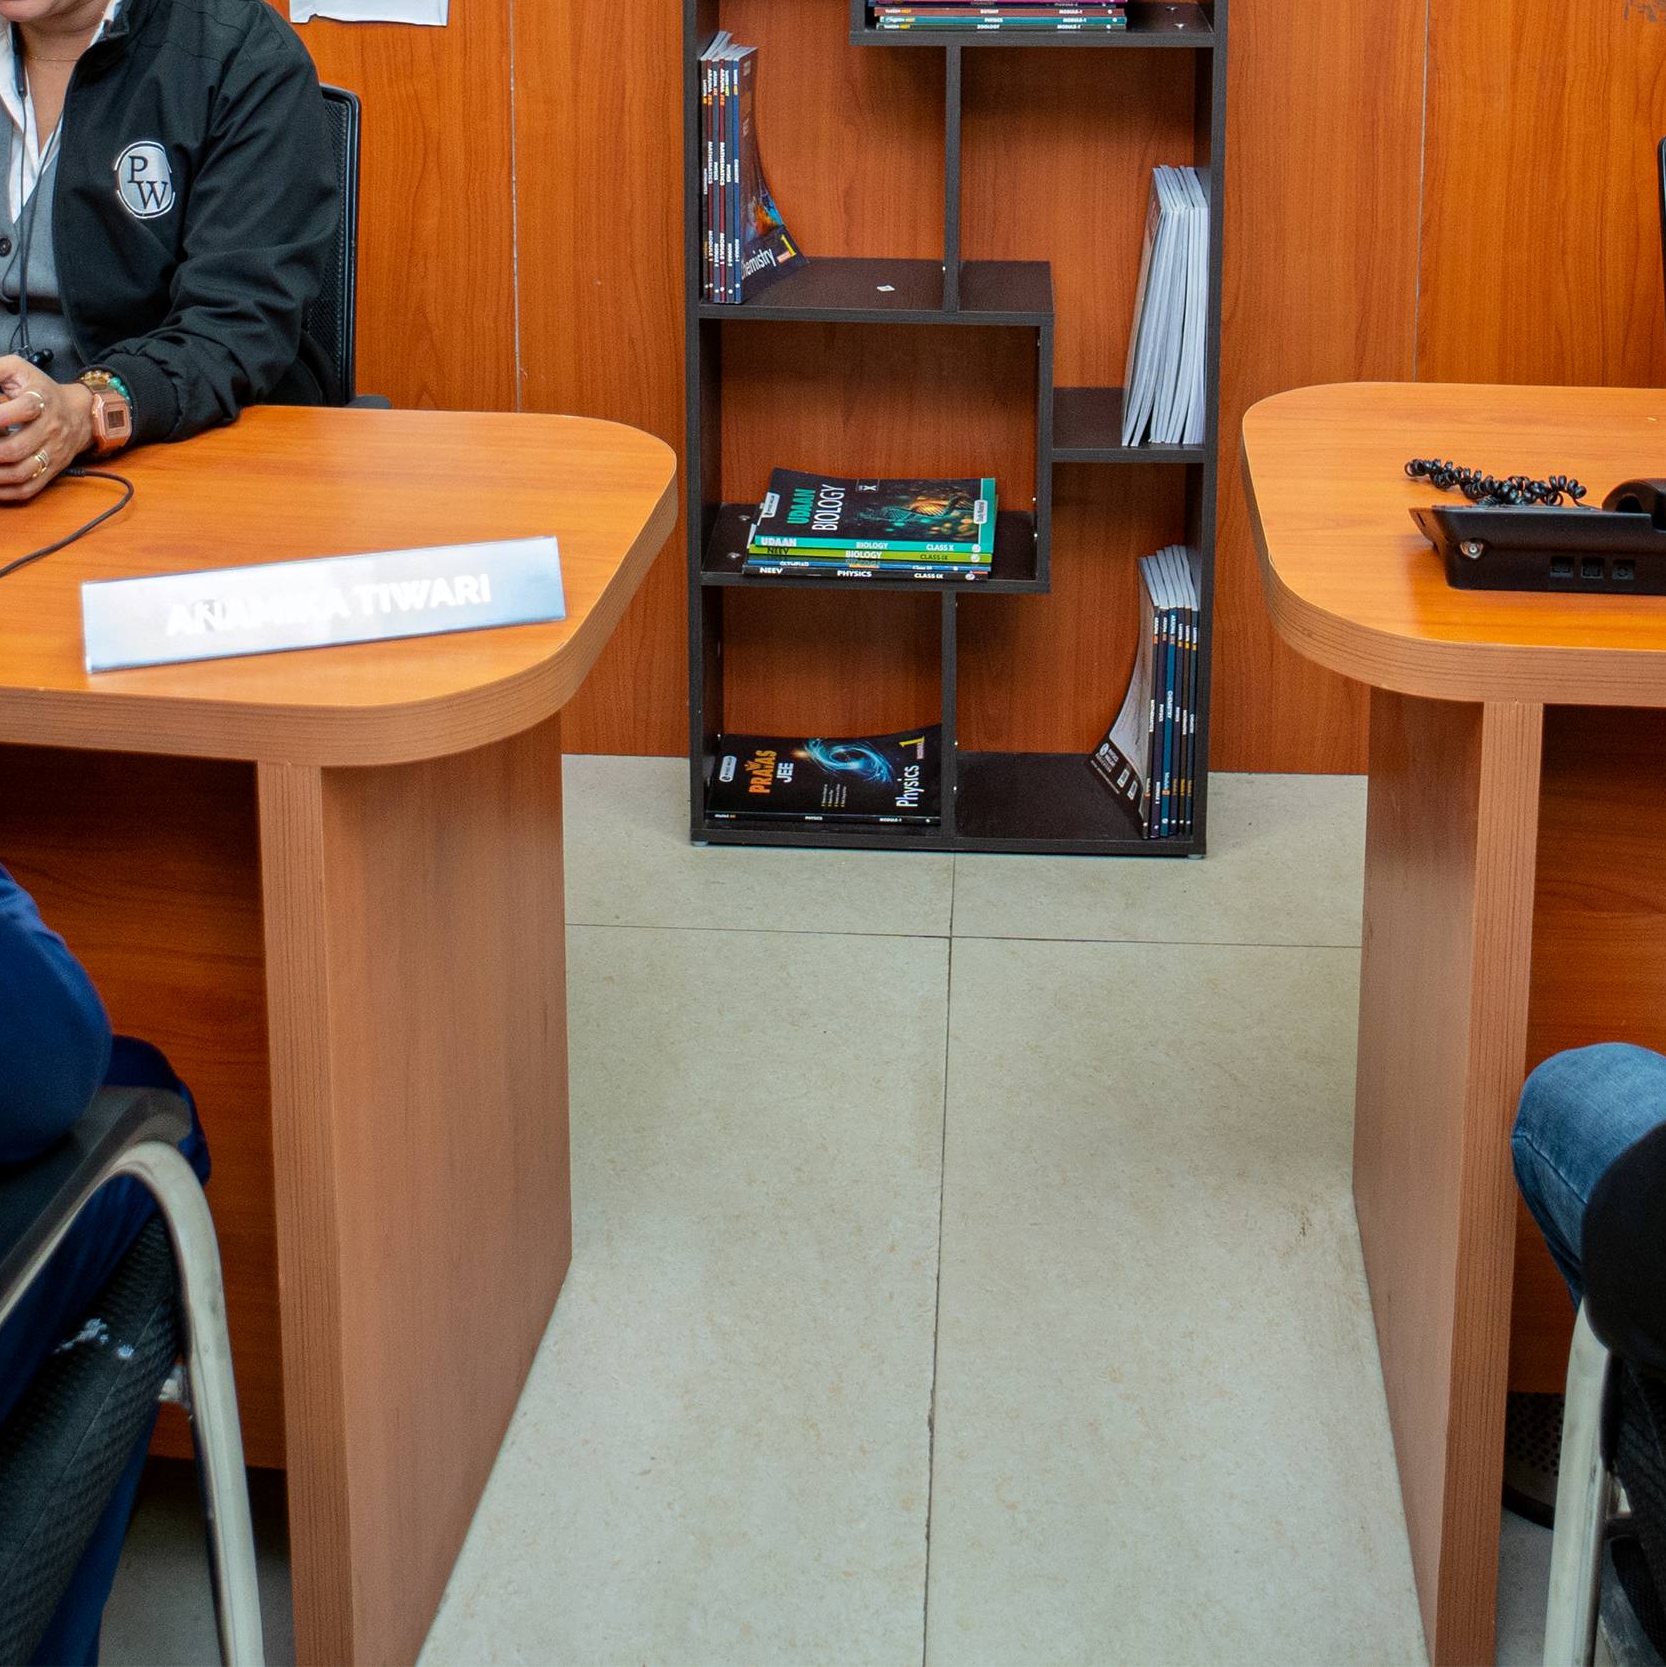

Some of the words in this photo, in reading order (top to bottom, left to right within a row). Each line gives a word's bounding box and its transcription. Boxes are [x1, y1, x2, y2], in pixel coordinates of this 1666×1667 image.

[787, 488, 816, 525] UDAAN
[811, 484, 845, 531] BIOLOGY
[760, 537, 797, 546] UDAAN
[856, 541, 889, 549] BIOLOGY
[926, 543, 947, 551] CLASS
[767, 547, 789, 555] NEEV
[845, 550, 882, 559] BIOLOGY
[837, 570, 872, 578] PHYSICS
[351, 573, 492, 616] TIWARI
[776, 762, 794, 783] JEE
[895, 765, 925, 807] Physics
